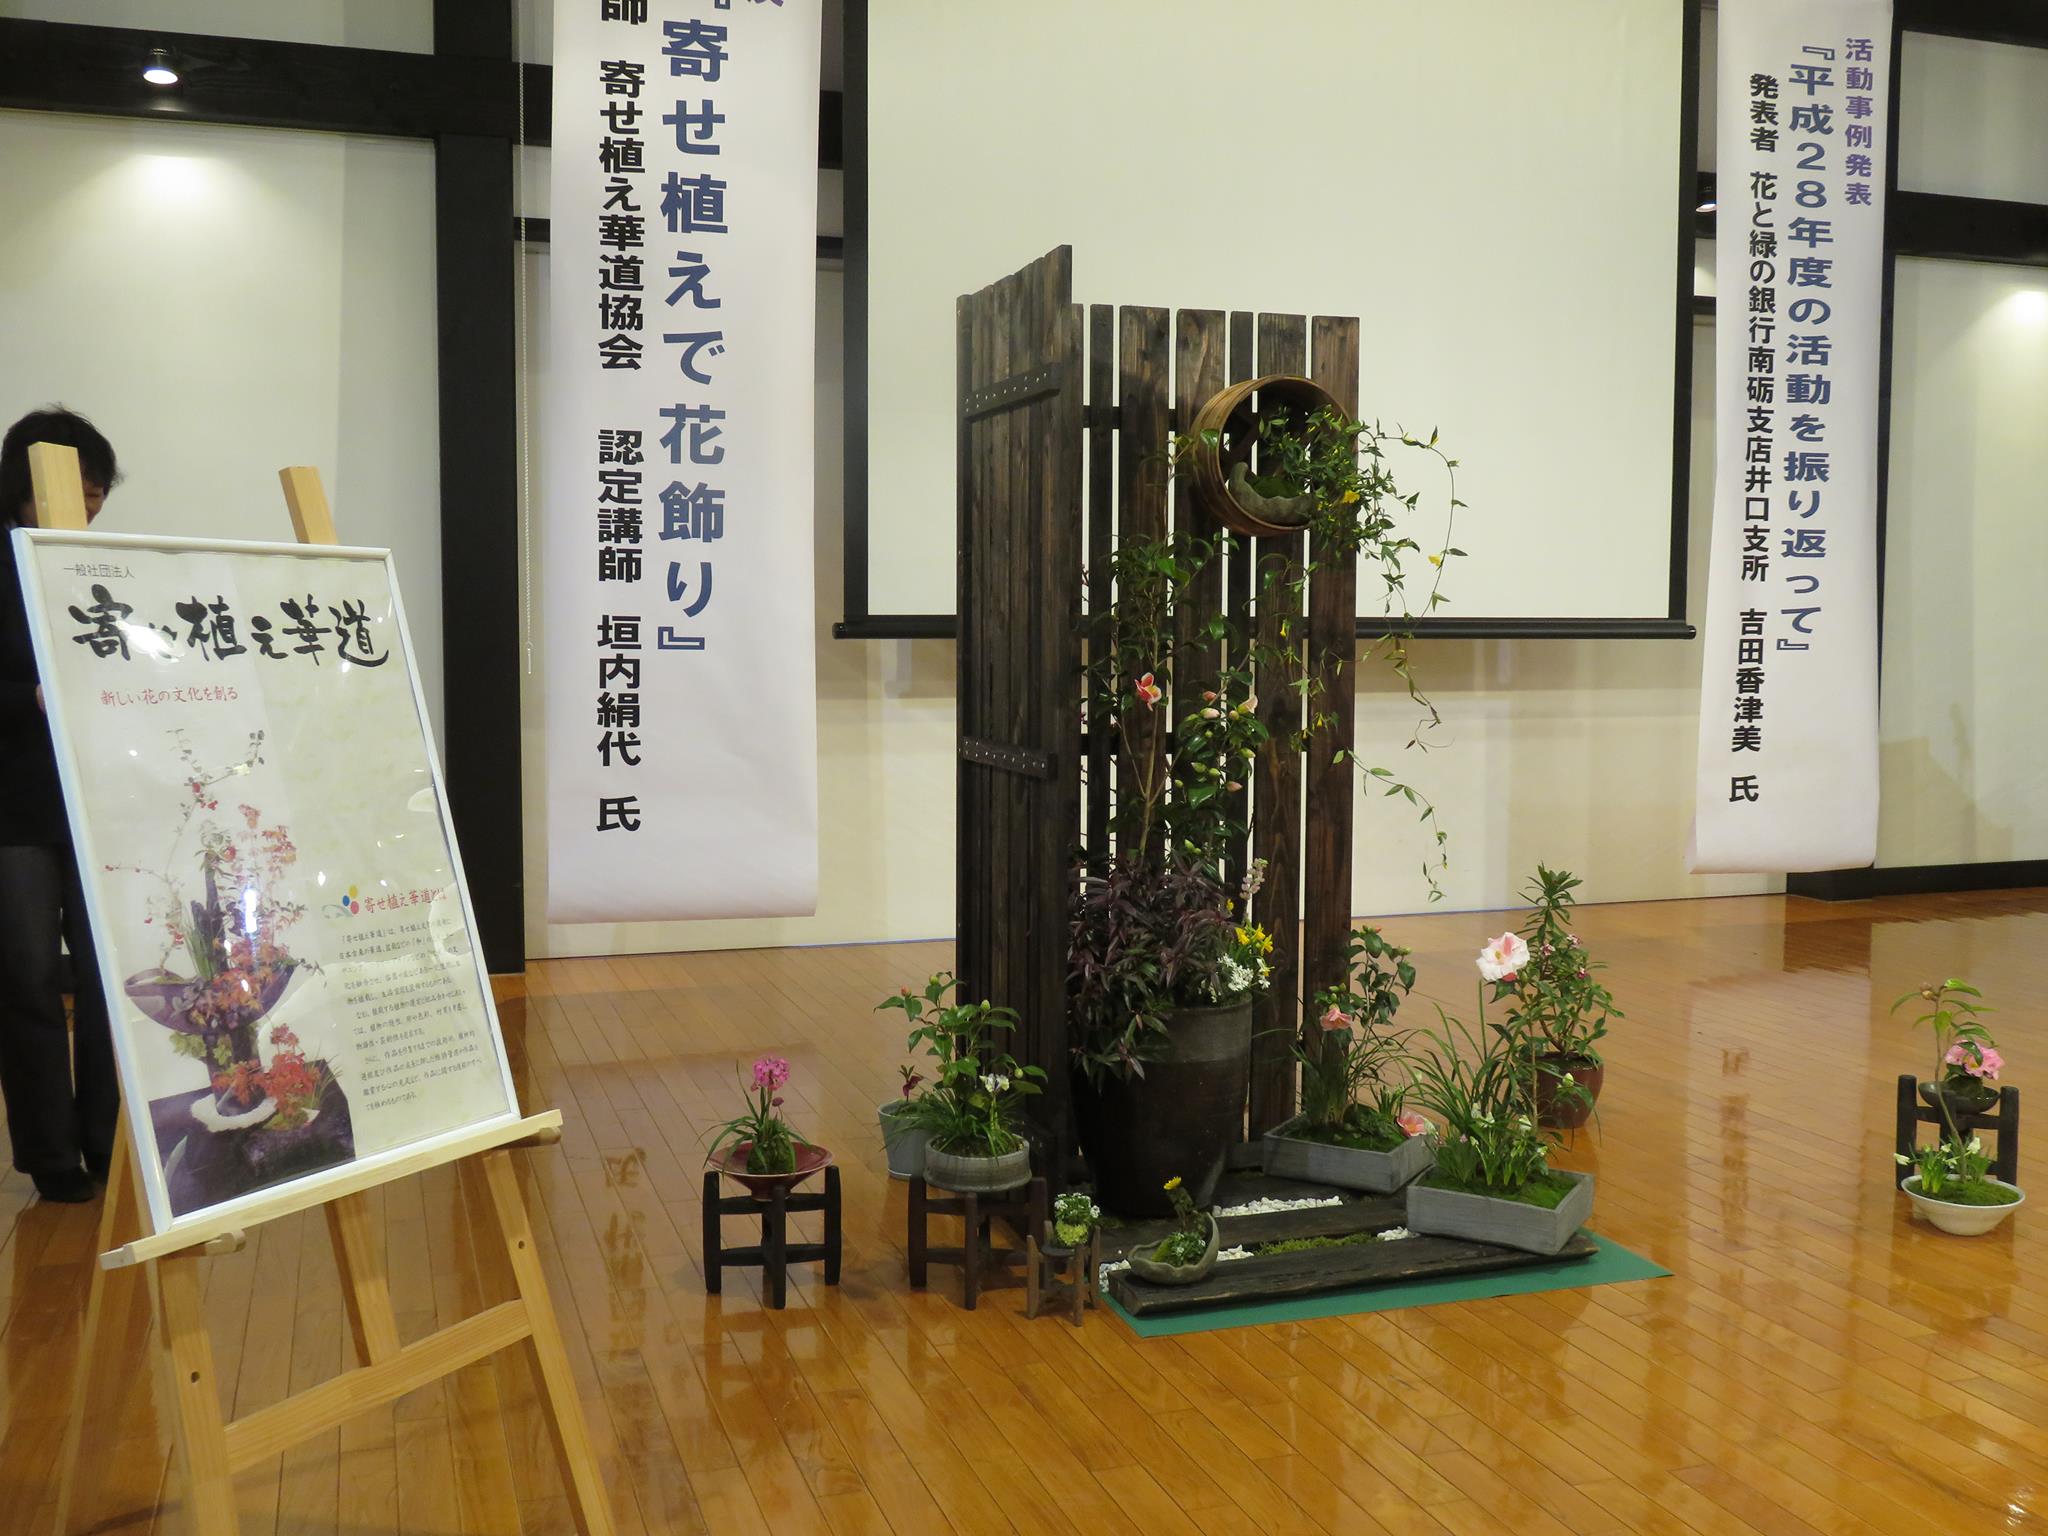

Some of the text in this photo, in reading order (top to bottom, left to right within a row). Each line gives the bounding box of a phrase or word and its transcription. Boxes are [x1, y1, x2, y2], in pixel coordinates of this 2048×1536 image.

[1844, 37, 1875, 207] 活動事例発表
[598, 60, 646, 371] 寄せ植え華道協会
[597, 429, 645, 584] 認定講師
[1728, 73, 1780, 803] 発表者 花と緑の銀行南砺支店井口支所 吉田香津美 氏
[101, 686, 239, 707] 新しい花の文化を創る
[596, 614, 642, 767] 垣内絹代
[596, 795, 641, 832] 氏
